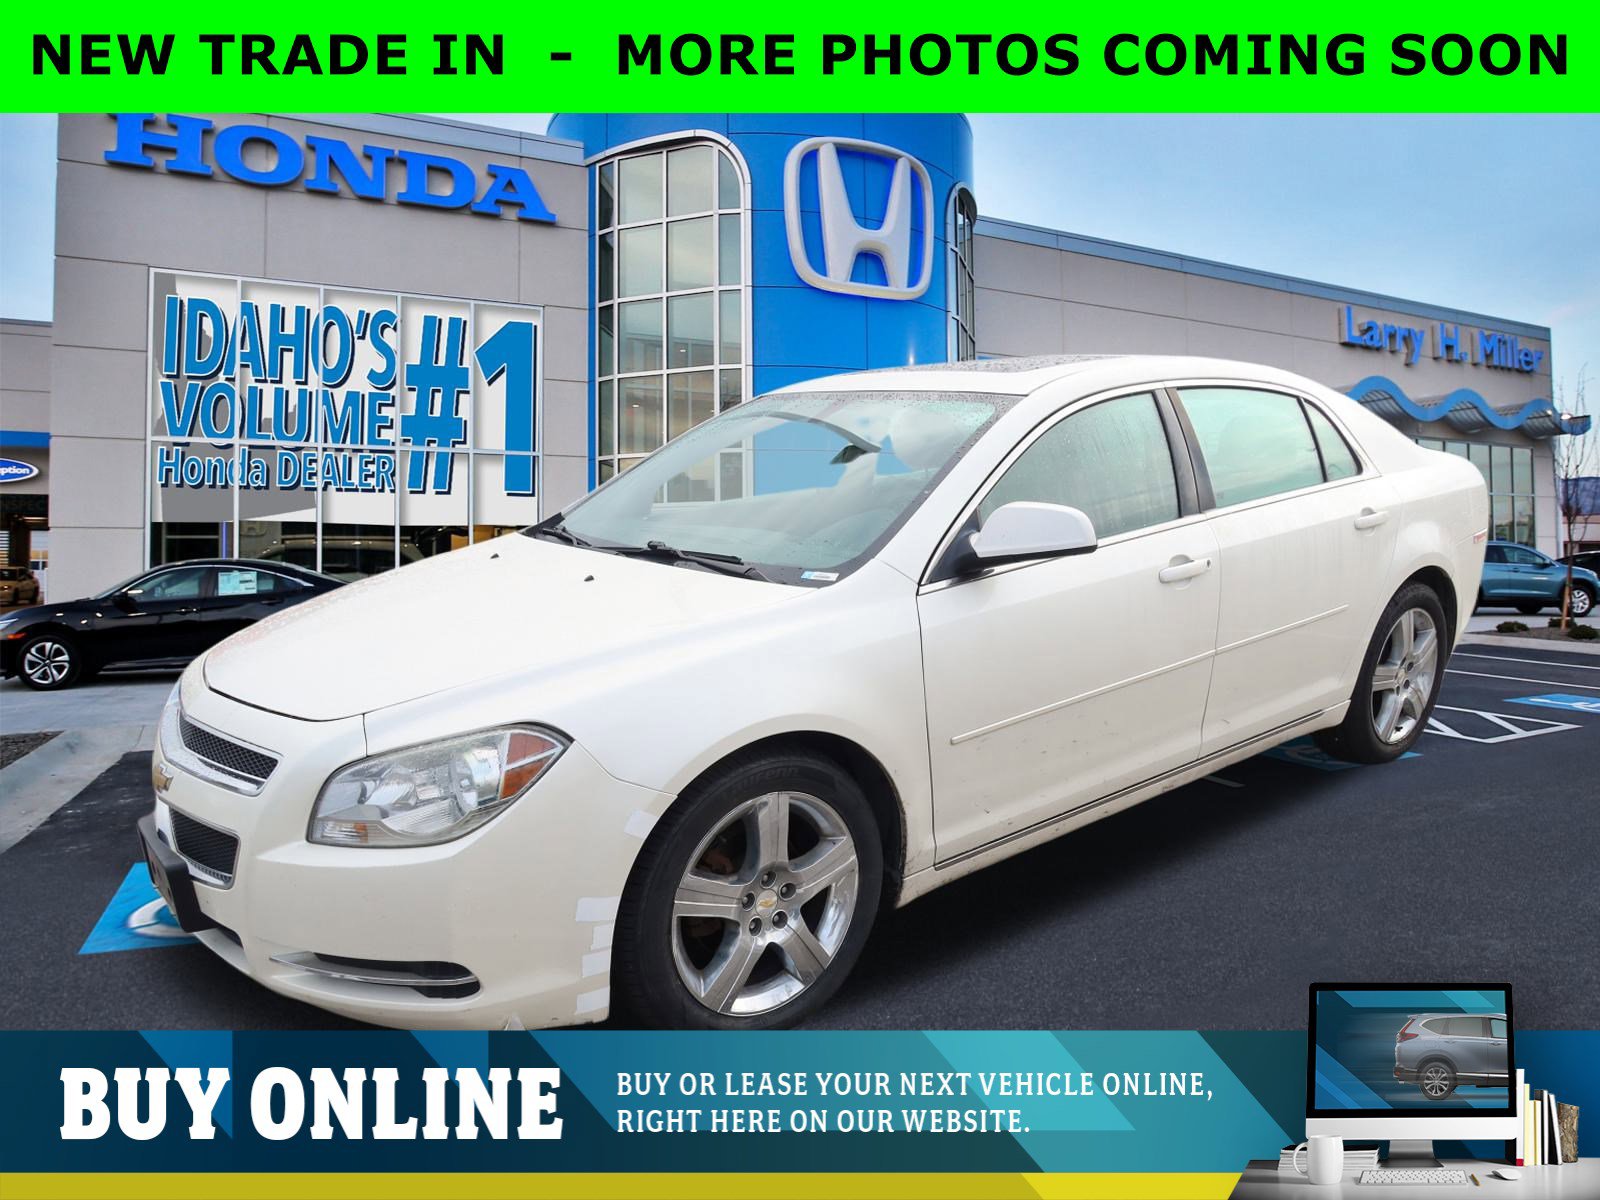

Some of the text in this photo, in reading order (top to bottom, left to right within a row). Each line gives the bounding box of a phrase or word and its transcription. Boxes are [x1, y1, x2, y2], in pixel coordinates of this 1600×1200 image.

[105, 113, 556, 223] HONDA
[163, 295, 397, 388] IDAHO'S
[1341, 305, 1545, 373] Larry H. Miller
[160, 381, 395, 447] VOLUME
[400, 315, 537, 494] #1
[157, 447, 395, 490] Honda DEALER
